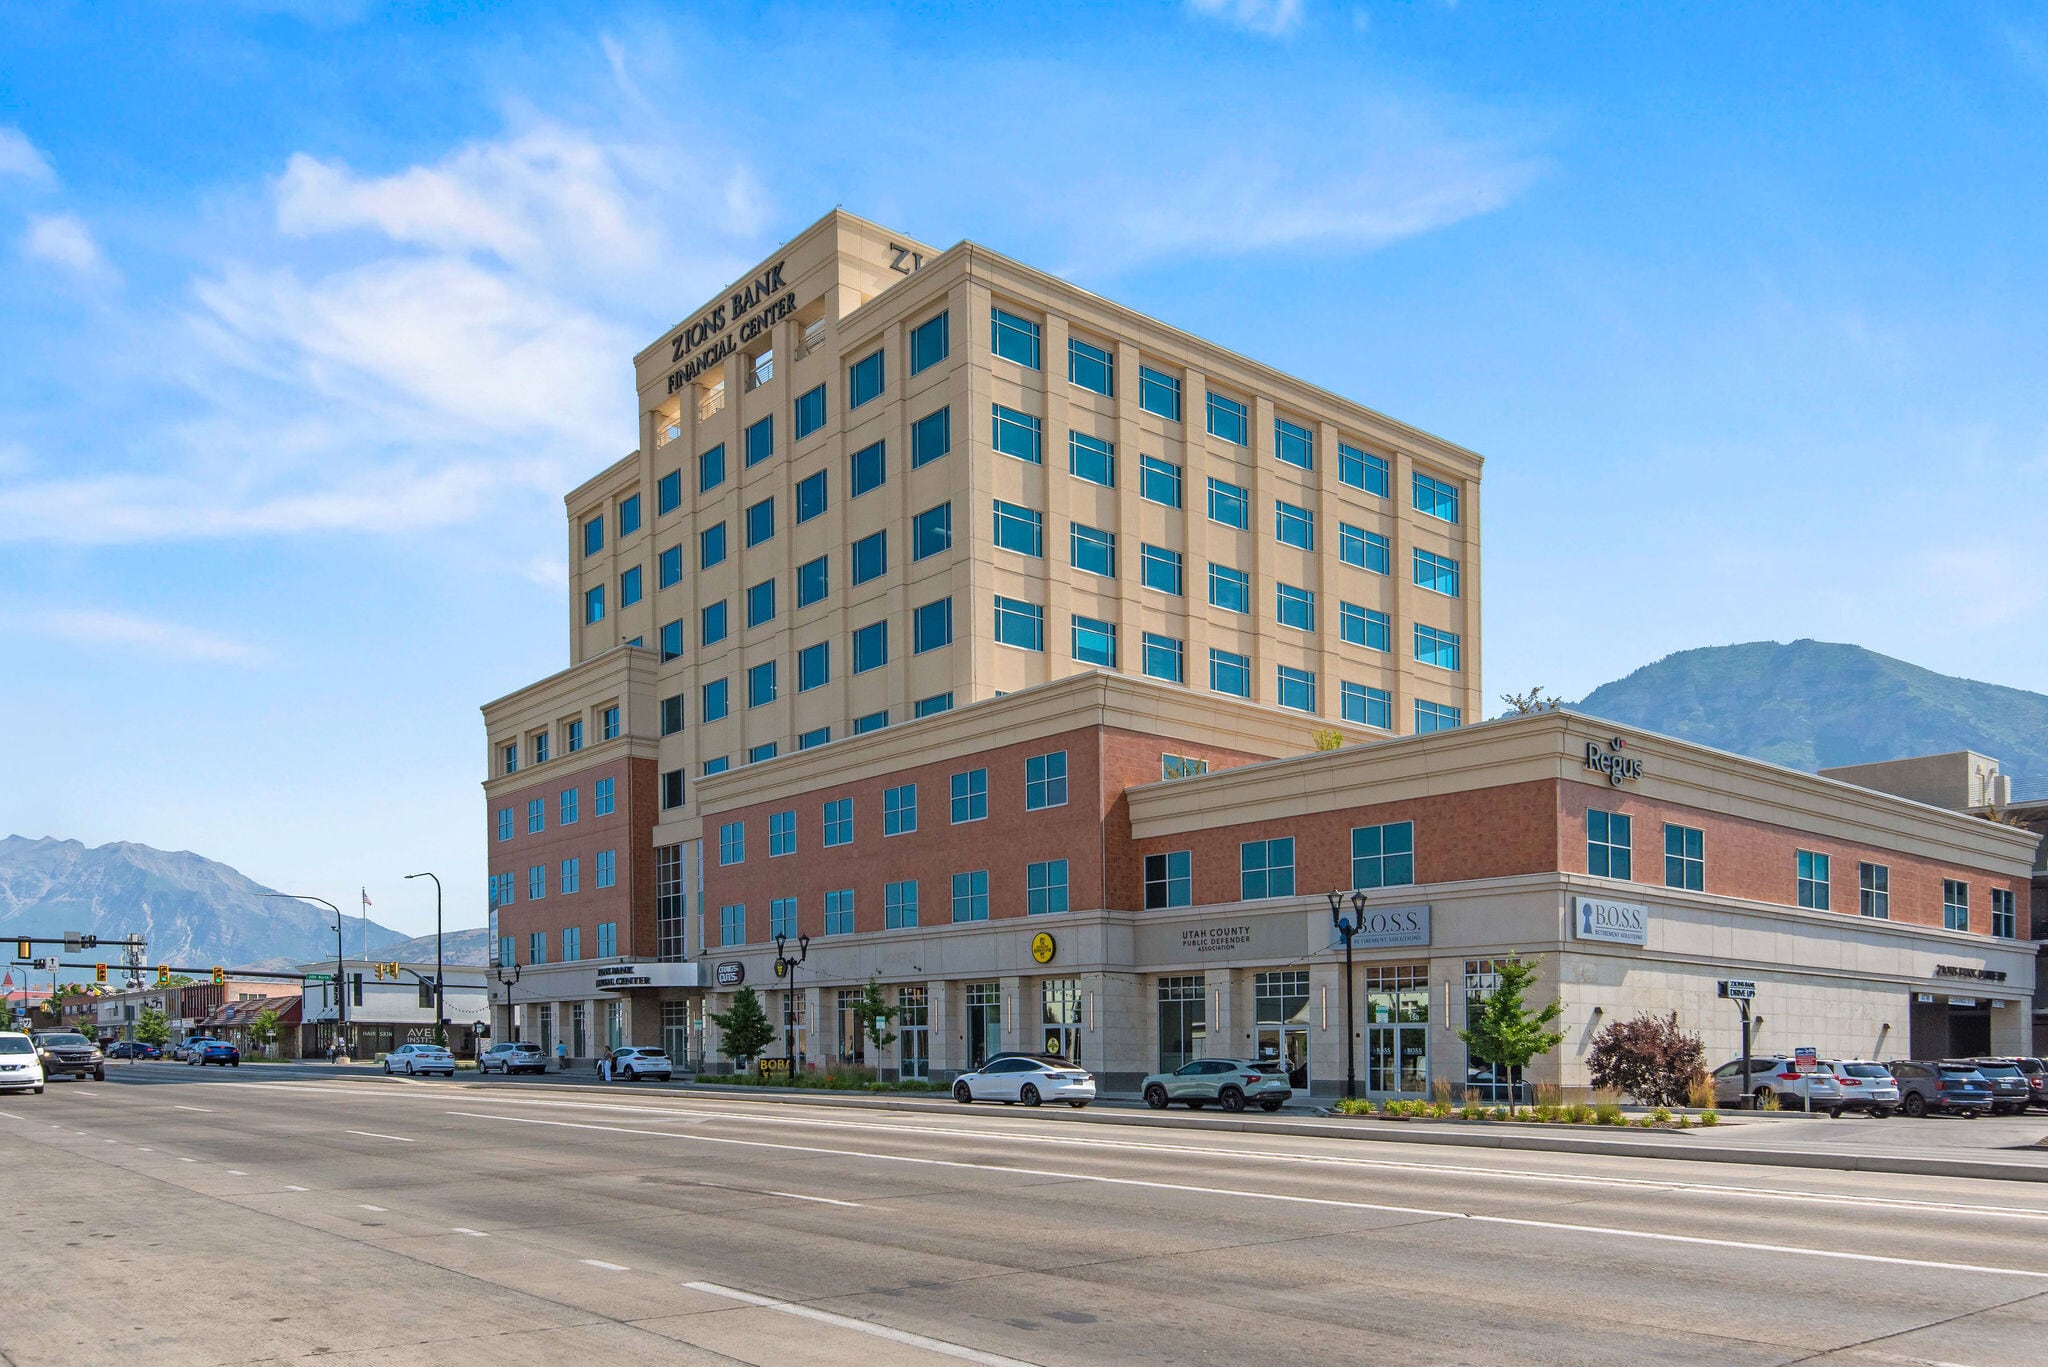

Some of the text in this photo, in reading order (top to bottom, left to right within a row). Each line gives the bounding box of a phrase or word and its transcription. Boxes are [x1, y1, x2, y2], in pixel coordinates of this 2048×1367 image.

[672, 261, 786, 362] ZIONS BANK
[667, 292, 797, 394] FINANCIAL CENTER
[1586, 742, 1643, 787] Regus
[1596, 905, 1642, 930] B.O.S.S.
[1182, 926, 1250, 939] UTAH COUNTY
[1210, 936, 1250, 945] DEFENDER
[1198, 944, 1235, 952] ASSOCIATION
[407, 1028, 449, 1037] AVEA
